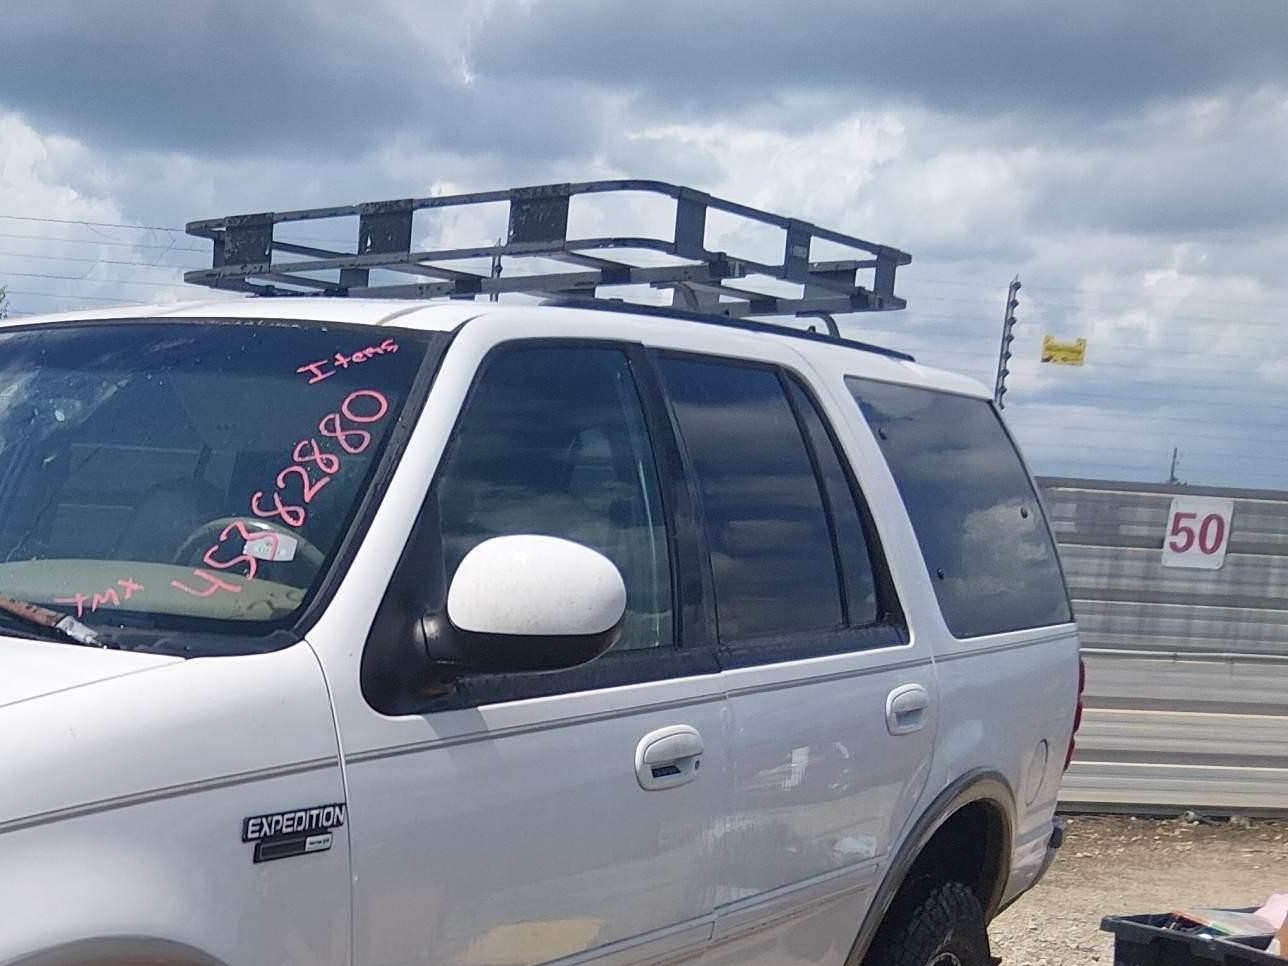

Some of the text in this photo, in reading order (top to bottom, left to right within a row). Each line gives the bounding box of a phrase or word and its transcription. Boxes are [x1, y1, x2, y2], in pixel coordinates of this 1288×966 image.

[171, 389, 388, 597] 45382880
[1169, 511, 1225, 556] 50
[247, 804, 346, 838] EXPEDITION
